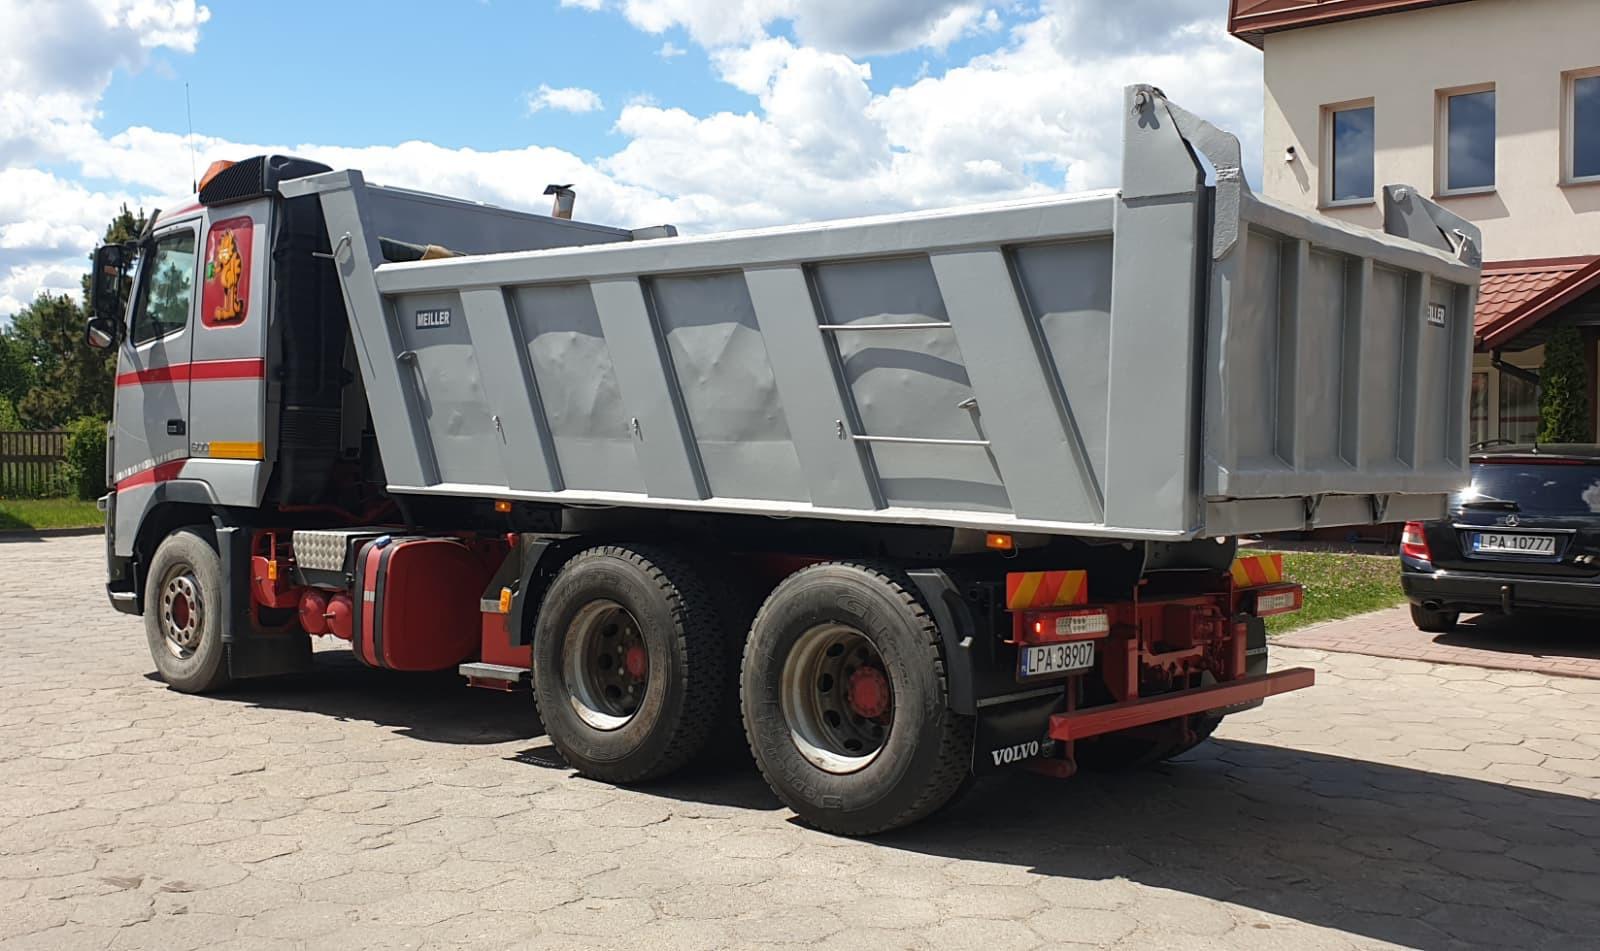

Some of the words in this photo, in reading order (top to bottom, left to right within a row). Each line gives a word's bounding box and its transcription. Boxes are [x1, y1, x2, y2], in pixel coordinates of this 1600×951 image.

[417, 311, 450, 327] MEILLER
[1480, 535, 1506, 549] LPA
[1512, 537, 1553, 551] 10777
[1028, 648, 1052, 673] LPA
[1056, 643, 1093, 669] 38907
[991, 740, 1039, 766] VOLVO
